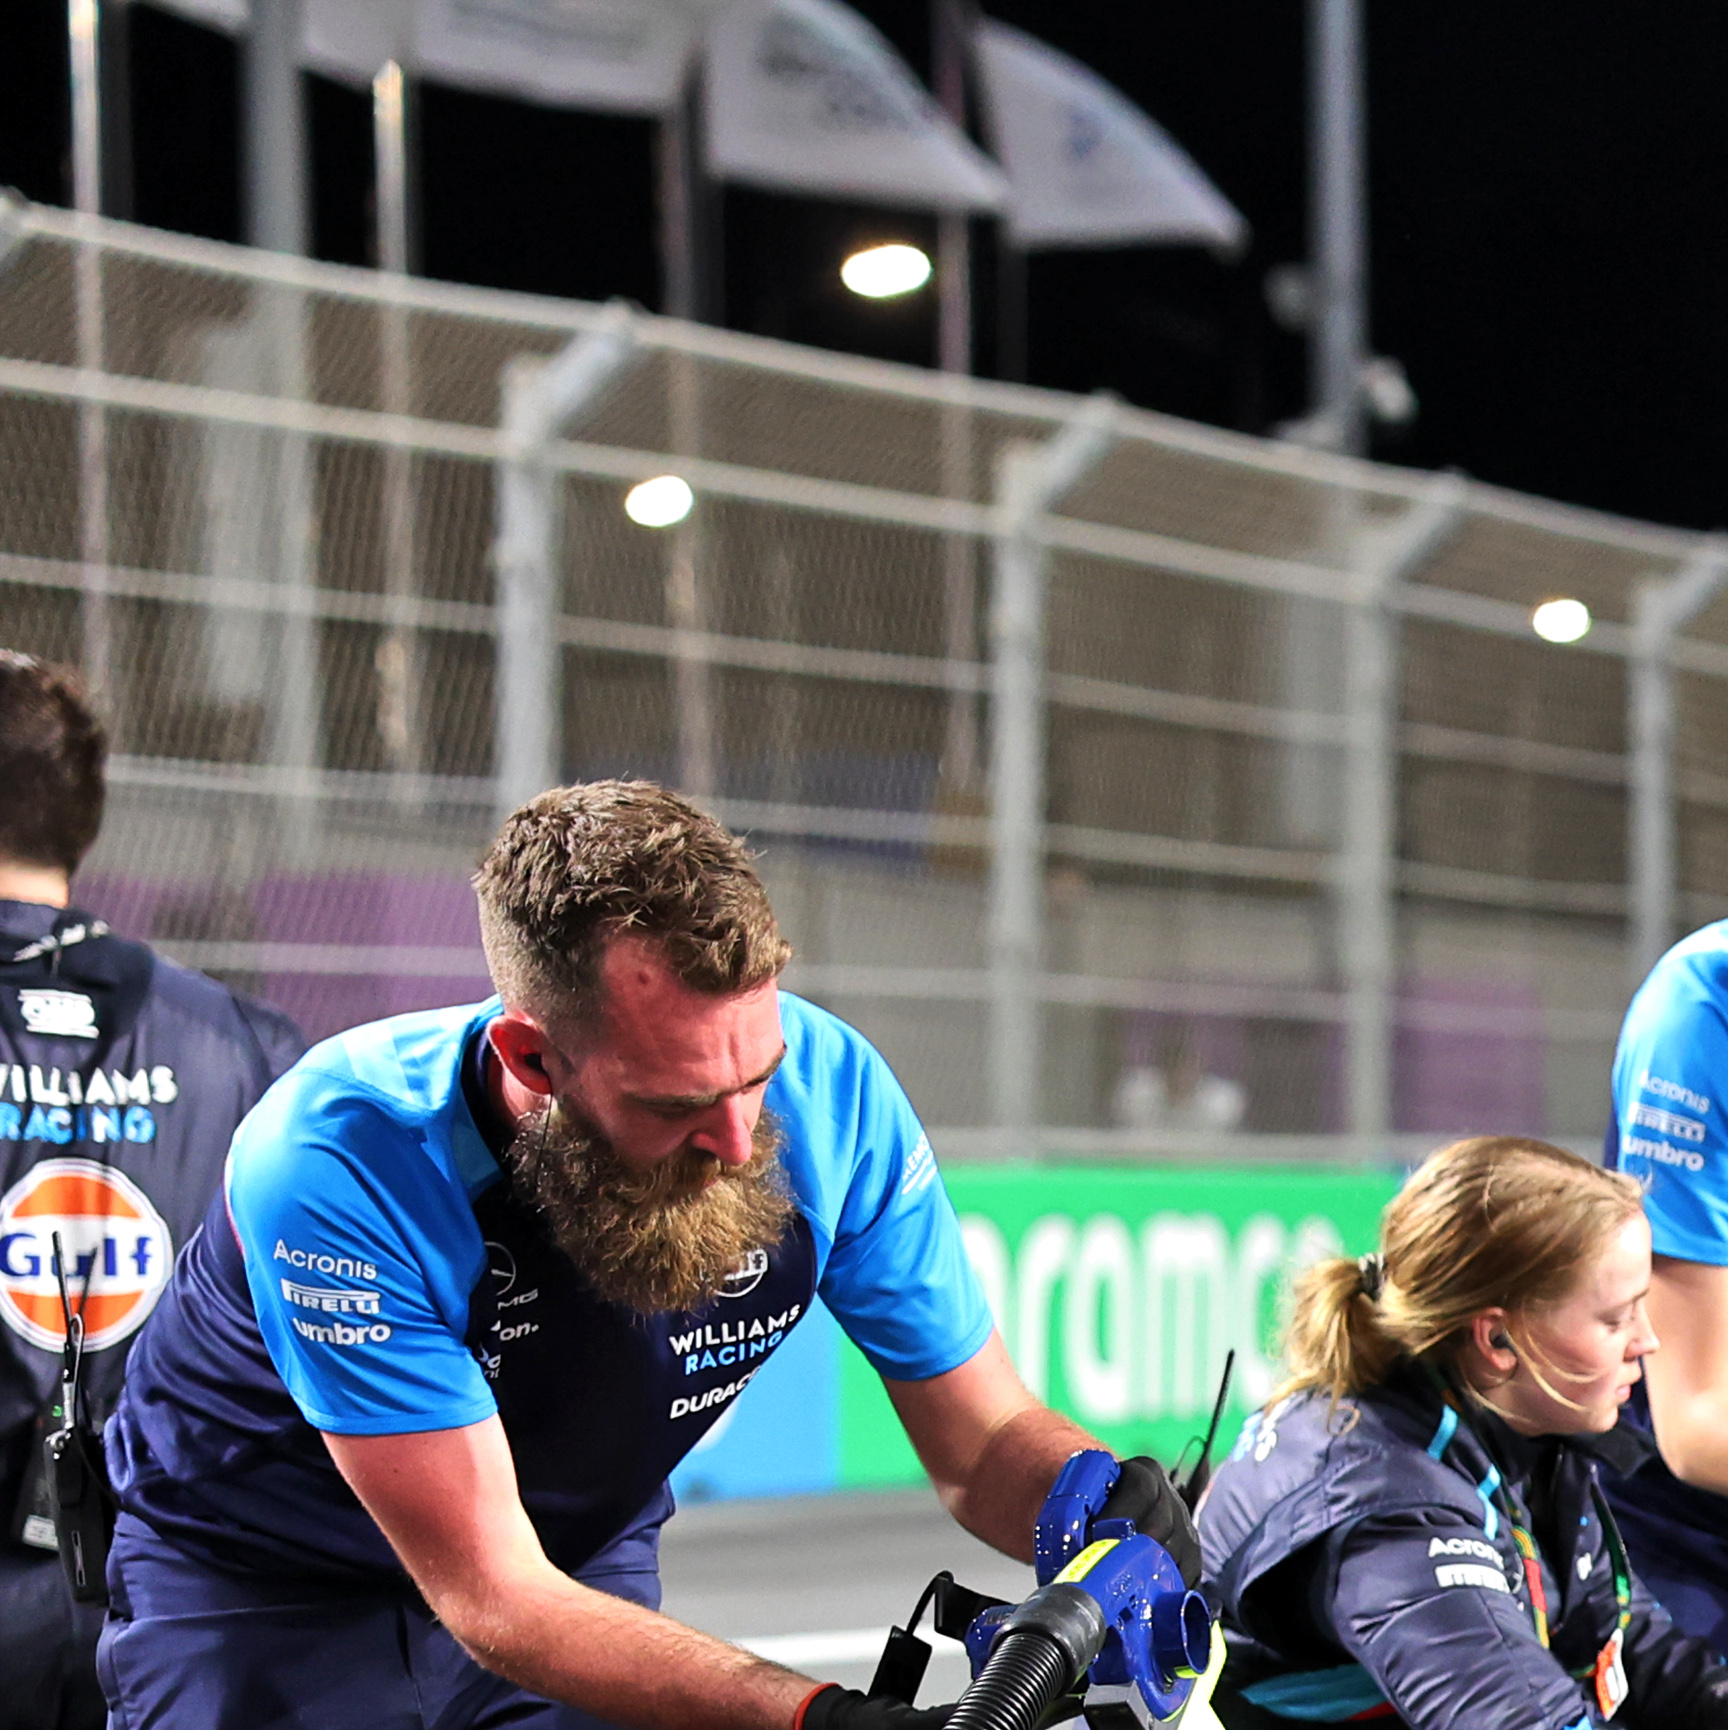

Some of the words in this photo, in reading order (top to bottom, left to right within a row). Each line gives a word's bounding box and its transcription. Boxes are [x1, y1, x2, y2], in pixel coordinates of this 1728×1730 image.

[273, 1238, 378, 1281] Acronis
[280, 1277, 381, 1315] PIRELLI
[292, 1317, 392, 1346] umbro
[669, 1303, 800, 1356] WILLIAMS
[685, 1330, 783, 1376] RACING
